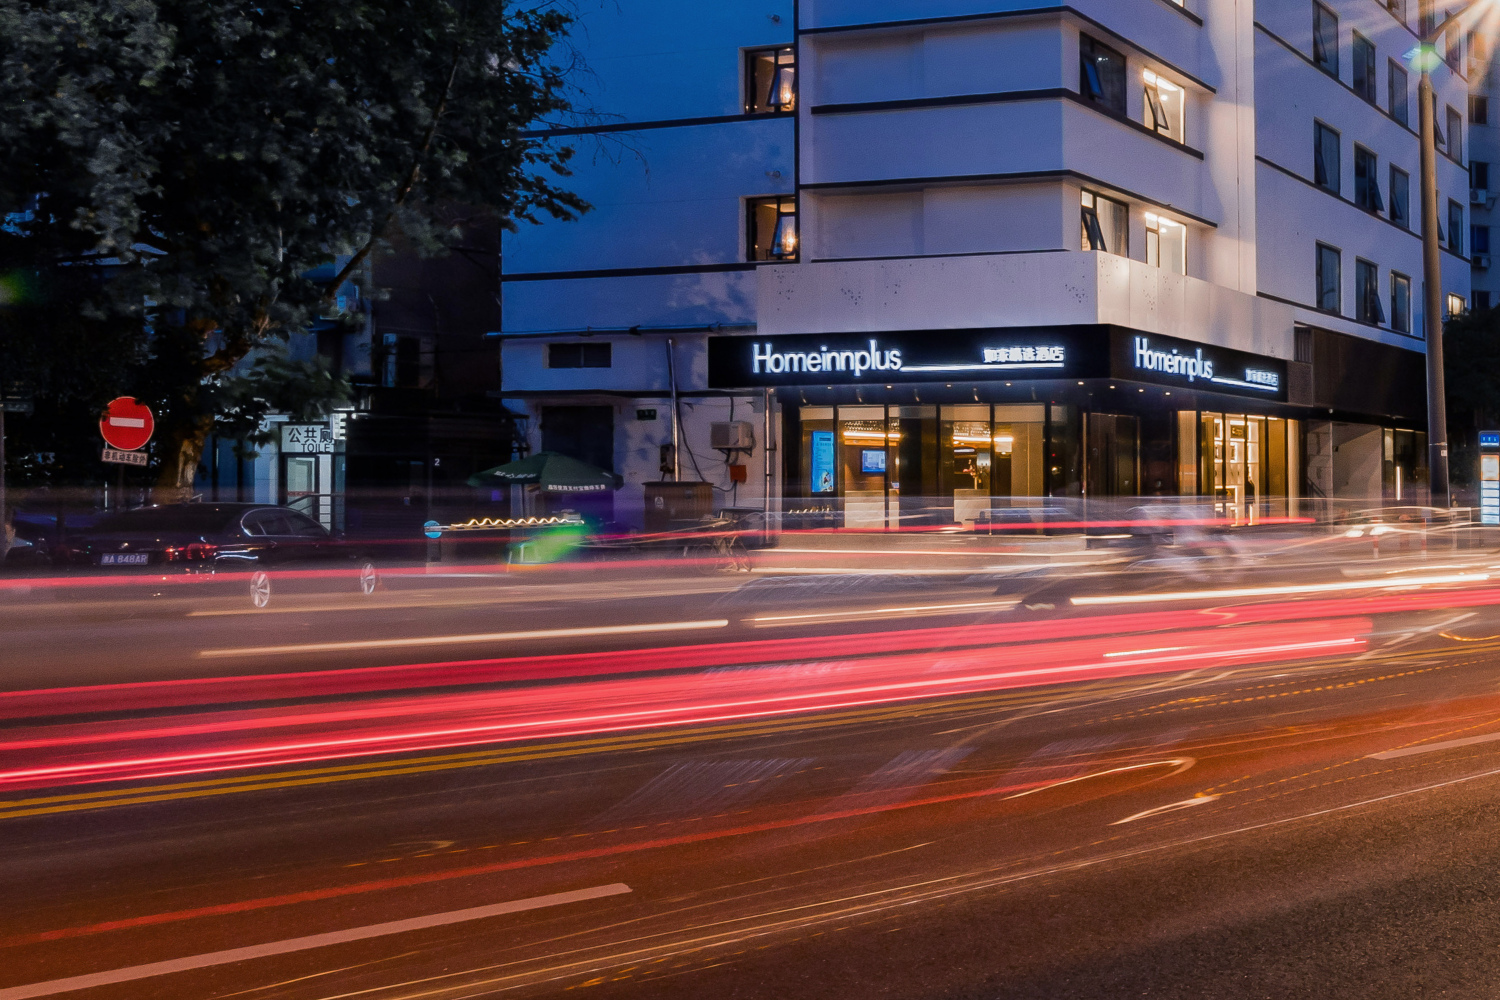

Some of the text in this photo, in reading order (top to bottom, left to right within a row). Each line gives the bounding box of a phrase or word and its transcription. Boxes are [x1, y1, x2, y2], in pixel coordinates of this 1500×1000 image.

[752, 339, 902, 377] Homeinnplus
[1135, 337, 1213, 382] Homeinnplus
[434, 458, 440, 466] 2
